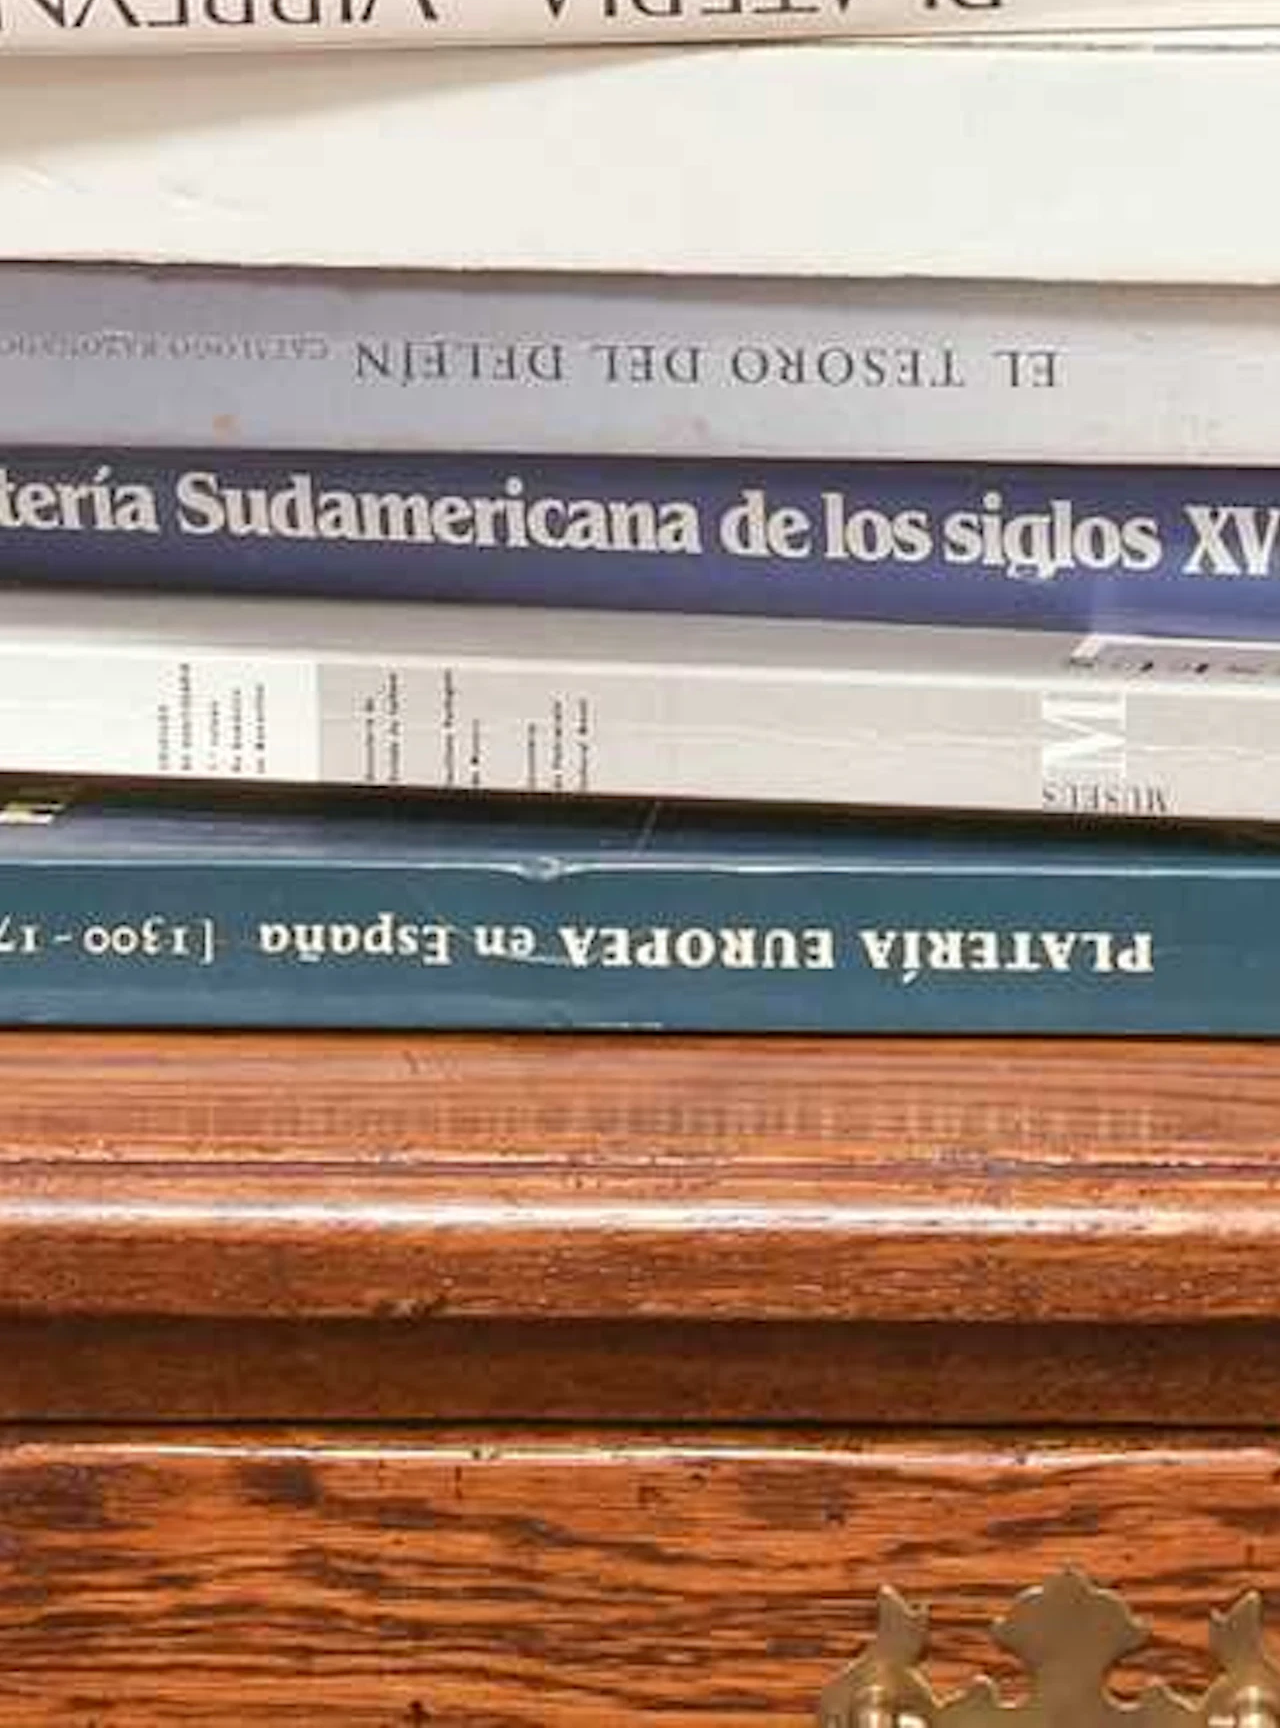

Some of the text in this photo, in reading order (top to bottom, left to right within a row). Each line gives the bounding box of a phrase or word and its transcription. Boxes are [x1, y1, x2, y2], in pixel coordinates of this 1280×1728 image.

[590, 343, 700, 385] DEL
[729, 345, 965, 389] TESORO
[993, 350, 1057, 388] EL
[176, 470, 704, 555] Sudamericana
[720, 489, 812, 558] de
[822, 492, 933, 562] los
[944, 493, 1162, 580] siglos
[260, 911, 452, 965] España
[473, 925, 536, 957] en
[559, 926, 835, 969] EUROPEA
[860, 929, 1154, 982] PLATERÍA
